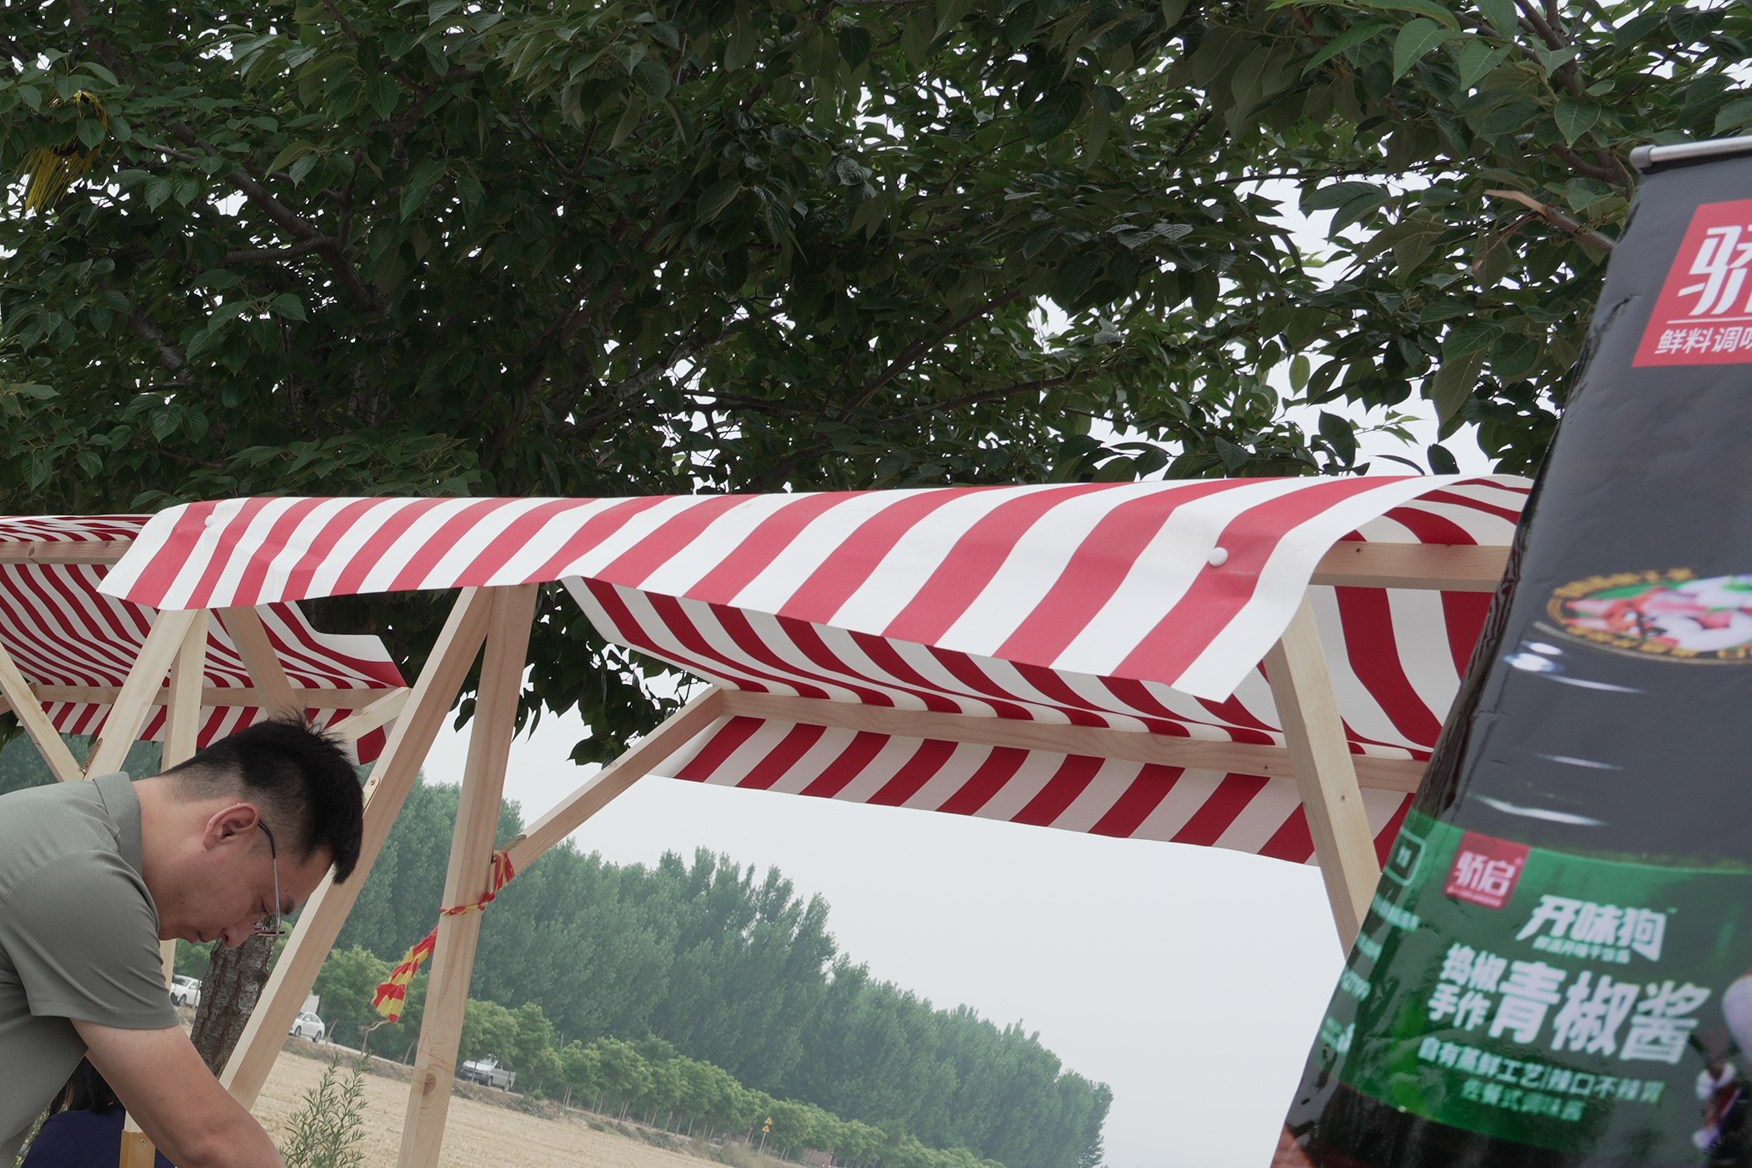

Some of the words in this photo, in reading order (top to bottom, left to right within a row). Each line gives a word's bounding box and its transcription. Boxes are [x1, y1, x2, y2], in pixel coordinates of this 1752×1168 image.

[1515, 894, 1668, 963] 开味狗
[1428, 981, 1492, 1032] 手作
[1489, 960, 1713, 1066] 青椒酱
